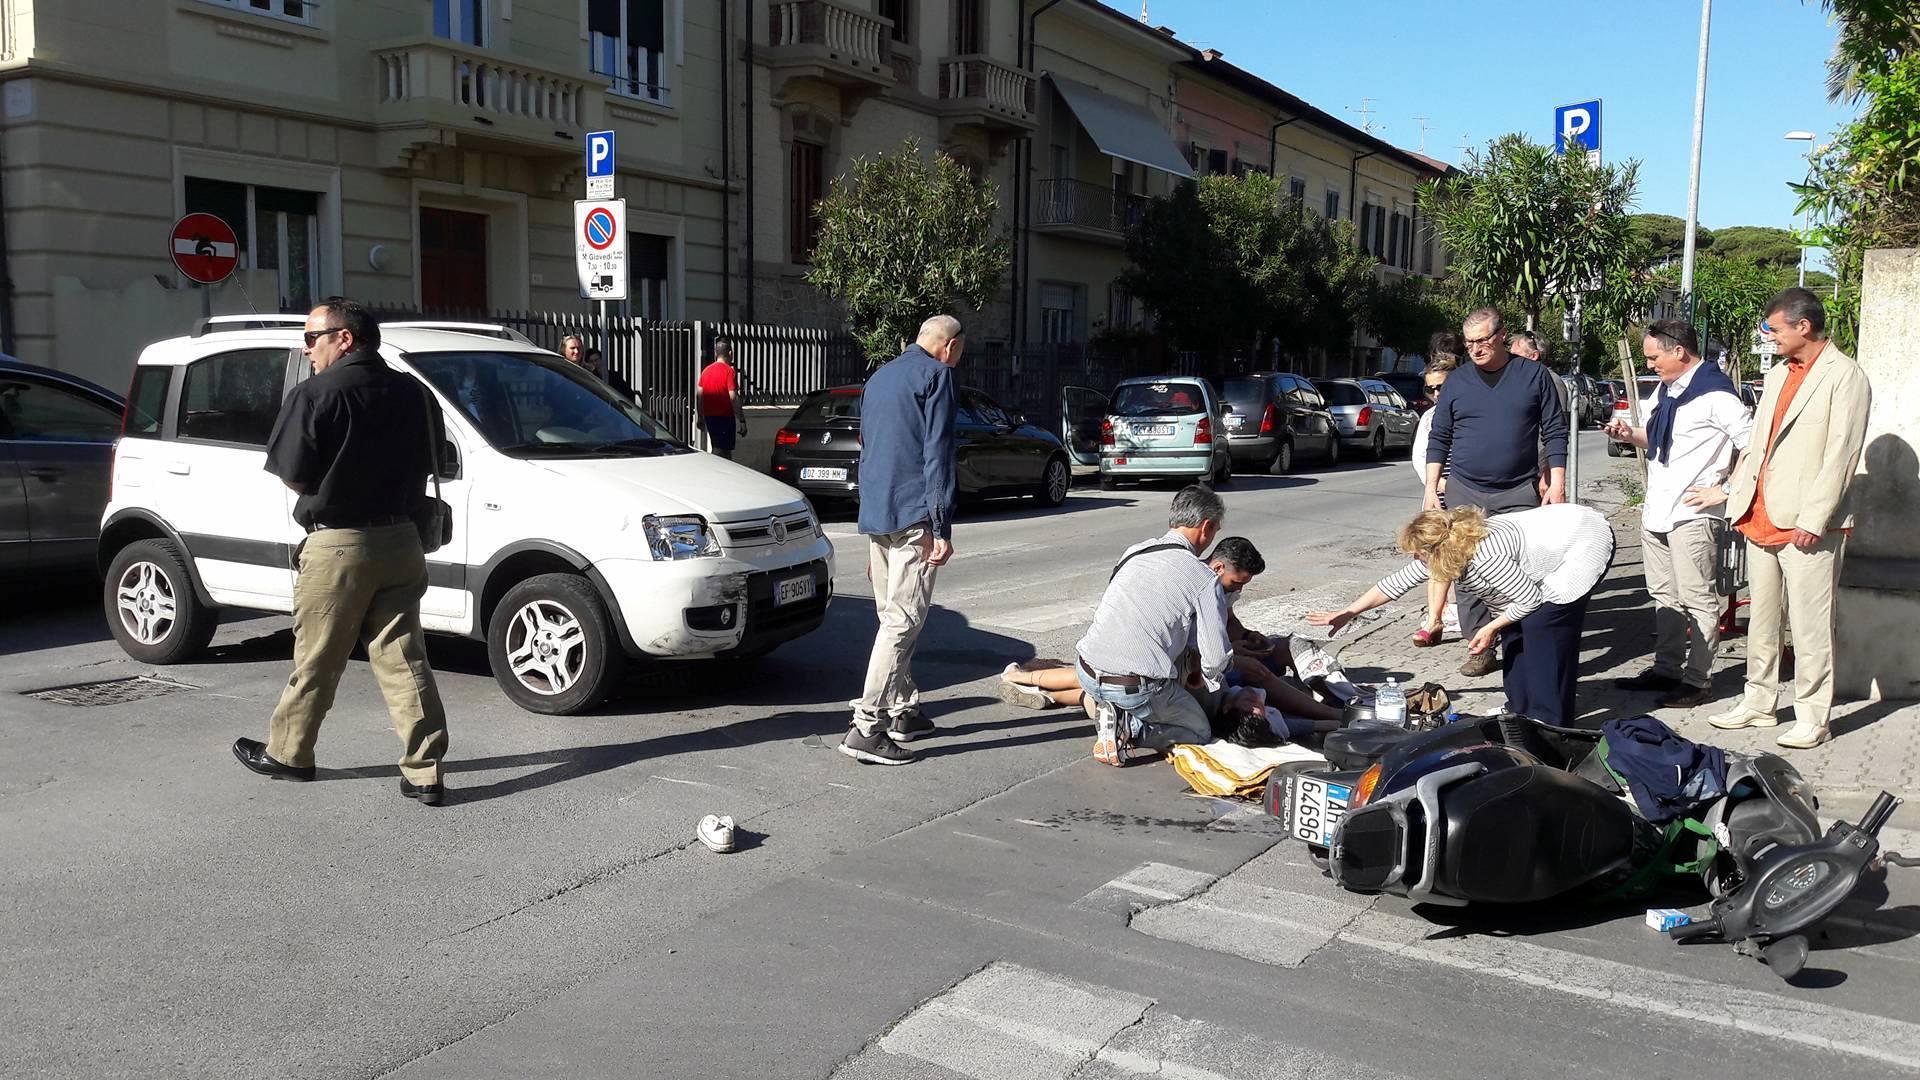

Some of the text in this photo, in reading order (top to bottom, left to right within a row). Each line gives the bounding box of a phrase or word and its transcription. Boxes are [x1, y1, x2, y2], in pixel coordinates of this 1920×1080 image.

[1563, 108, 1591, 149] P
[591, 137, 608, 173] P
[1283, 776, 1293, 832] SUPERCAR
[1299, 781, 1321, 840] 64696
